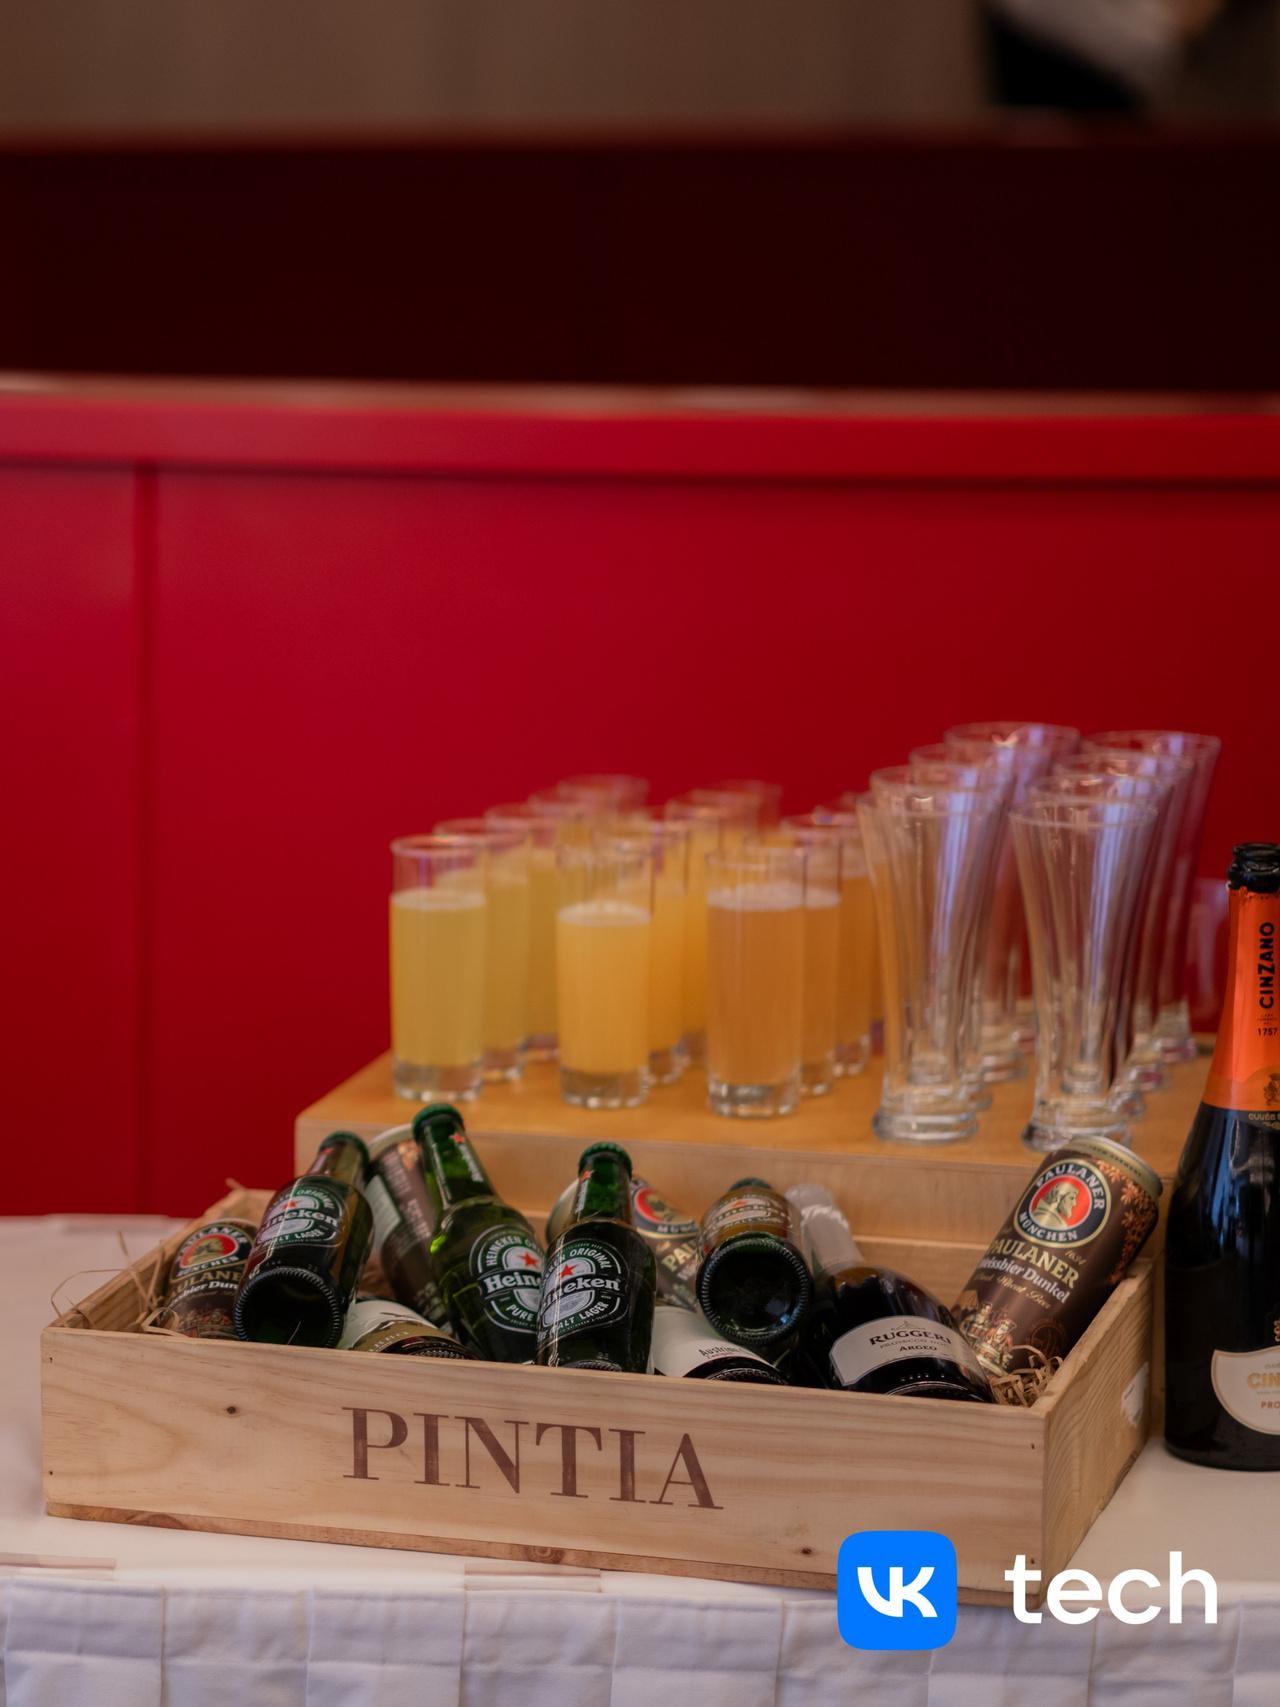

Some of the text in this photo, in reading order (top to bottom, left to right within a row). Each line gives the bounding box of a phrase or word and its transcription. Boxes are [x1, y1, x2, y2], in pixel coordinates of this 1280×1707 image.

[1258, 922, 1275, 1009] CINZANO
[1036, 1162, 1105, 1210] PAULANER
[264, 1209, 338, 1229] ineken
[1019, 1212, 1078, 1242] MÜNCHEN
[486, 1235, 523, 1266] HEINEKEN
[569, 1247, 612, 1269] ORIGINAL
[986, 1238, 1079, 1289] PAULANER
[170, 1271, 243, 1298] AULANE
[483, 1272, 541, 1293] Hein
[543, 1277, 620, 1306] ineken
[1022, 1267, 1071, 1304] Dunkel
[506, 1304, 534, 1322] PURE
[578, 1301, 609, 1320] LAGER
[869, 1330, 952, 1346] RUGGERI
[341, 1407, 724, 1510] PINTIA
